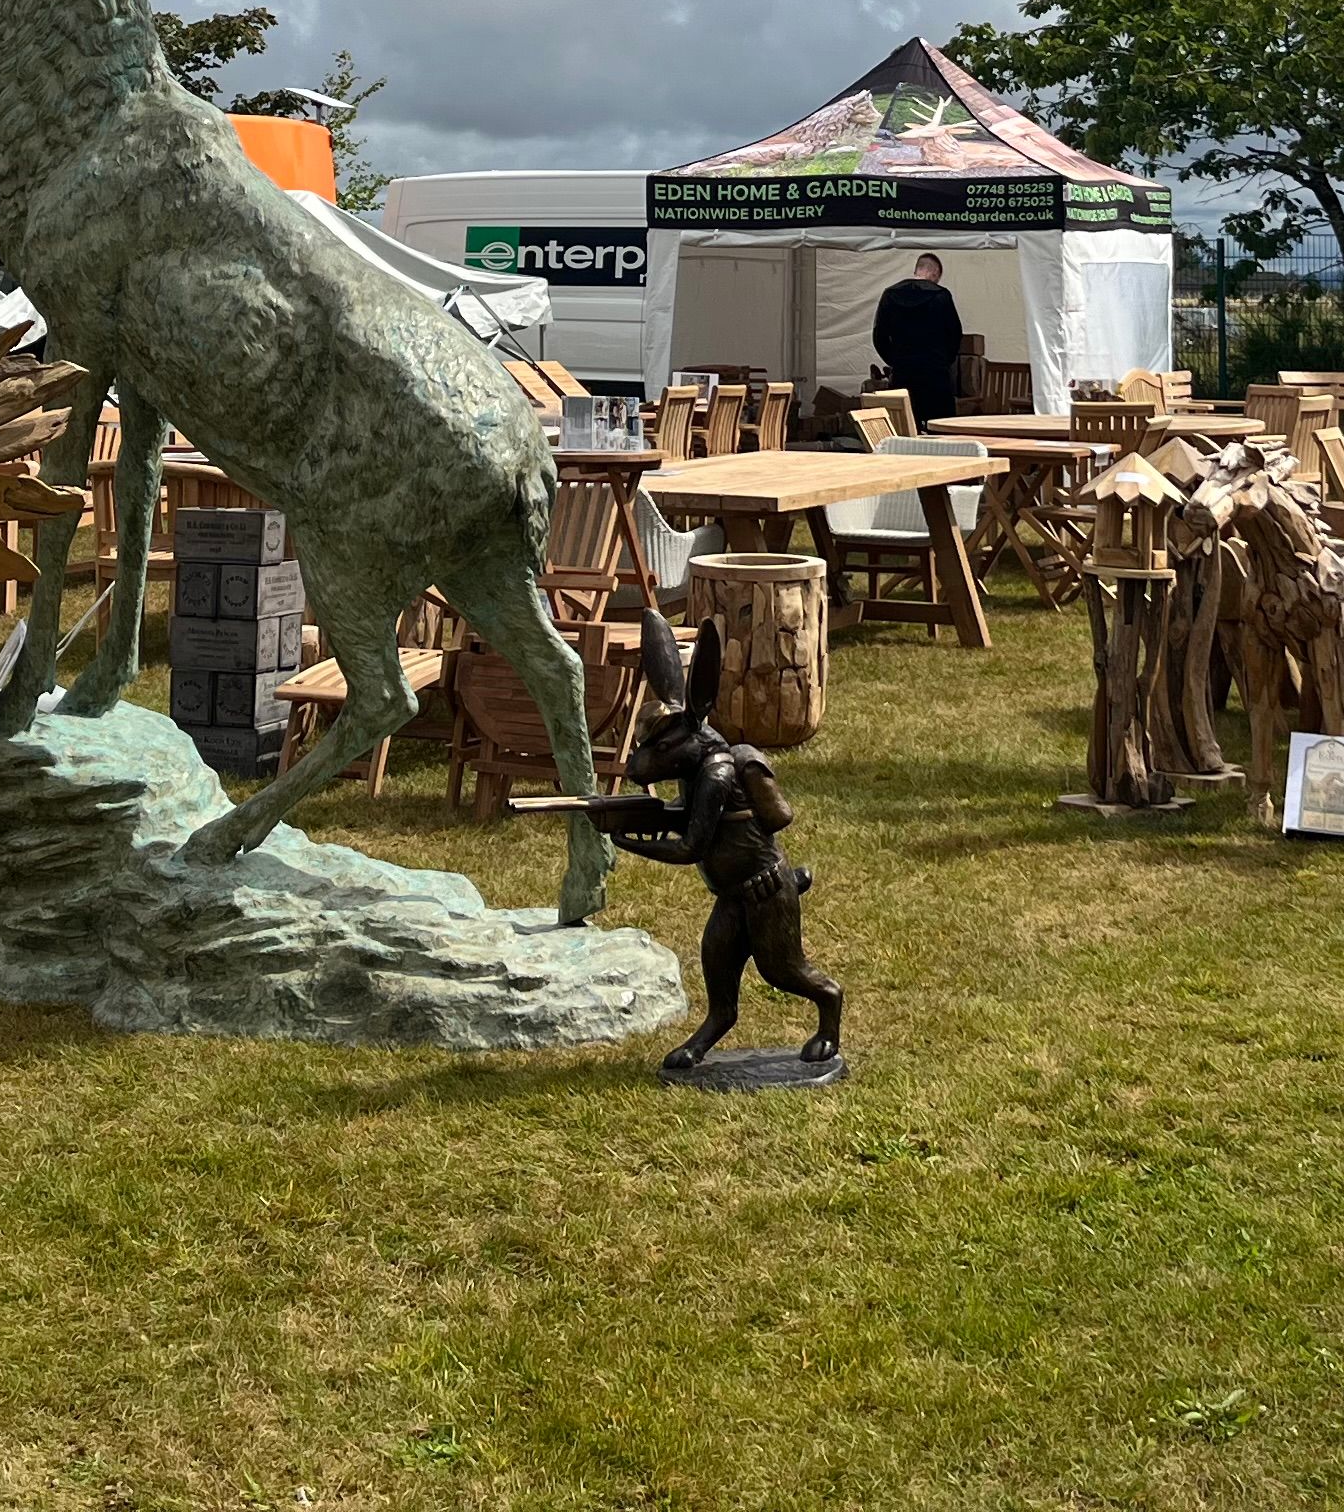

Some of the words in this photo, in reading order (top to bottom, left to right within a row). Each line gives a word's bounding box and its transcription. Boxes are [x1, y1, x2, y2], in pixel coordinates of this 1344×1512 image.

[654, 183, 711, 201] EDEN
[717, 183, 780, 201] HOME
[786, 183, 800, 200] &
[806, 180, 898, 199] GARDEN
[966, 184, 1005, 195] 07748
[1008, 183, 1054, 194] 505259
[966, 197, 1005, 208] 07970
[1008, 196, 1054, 207] 675025
[654, 207, 749, 220] NATIONWIDE
[753, 205, 824, 220] DELIVERY
[878, 208, 1054, 224] edenhomeandgarden.co.uk
[464, 240, 645, 279] enterp
